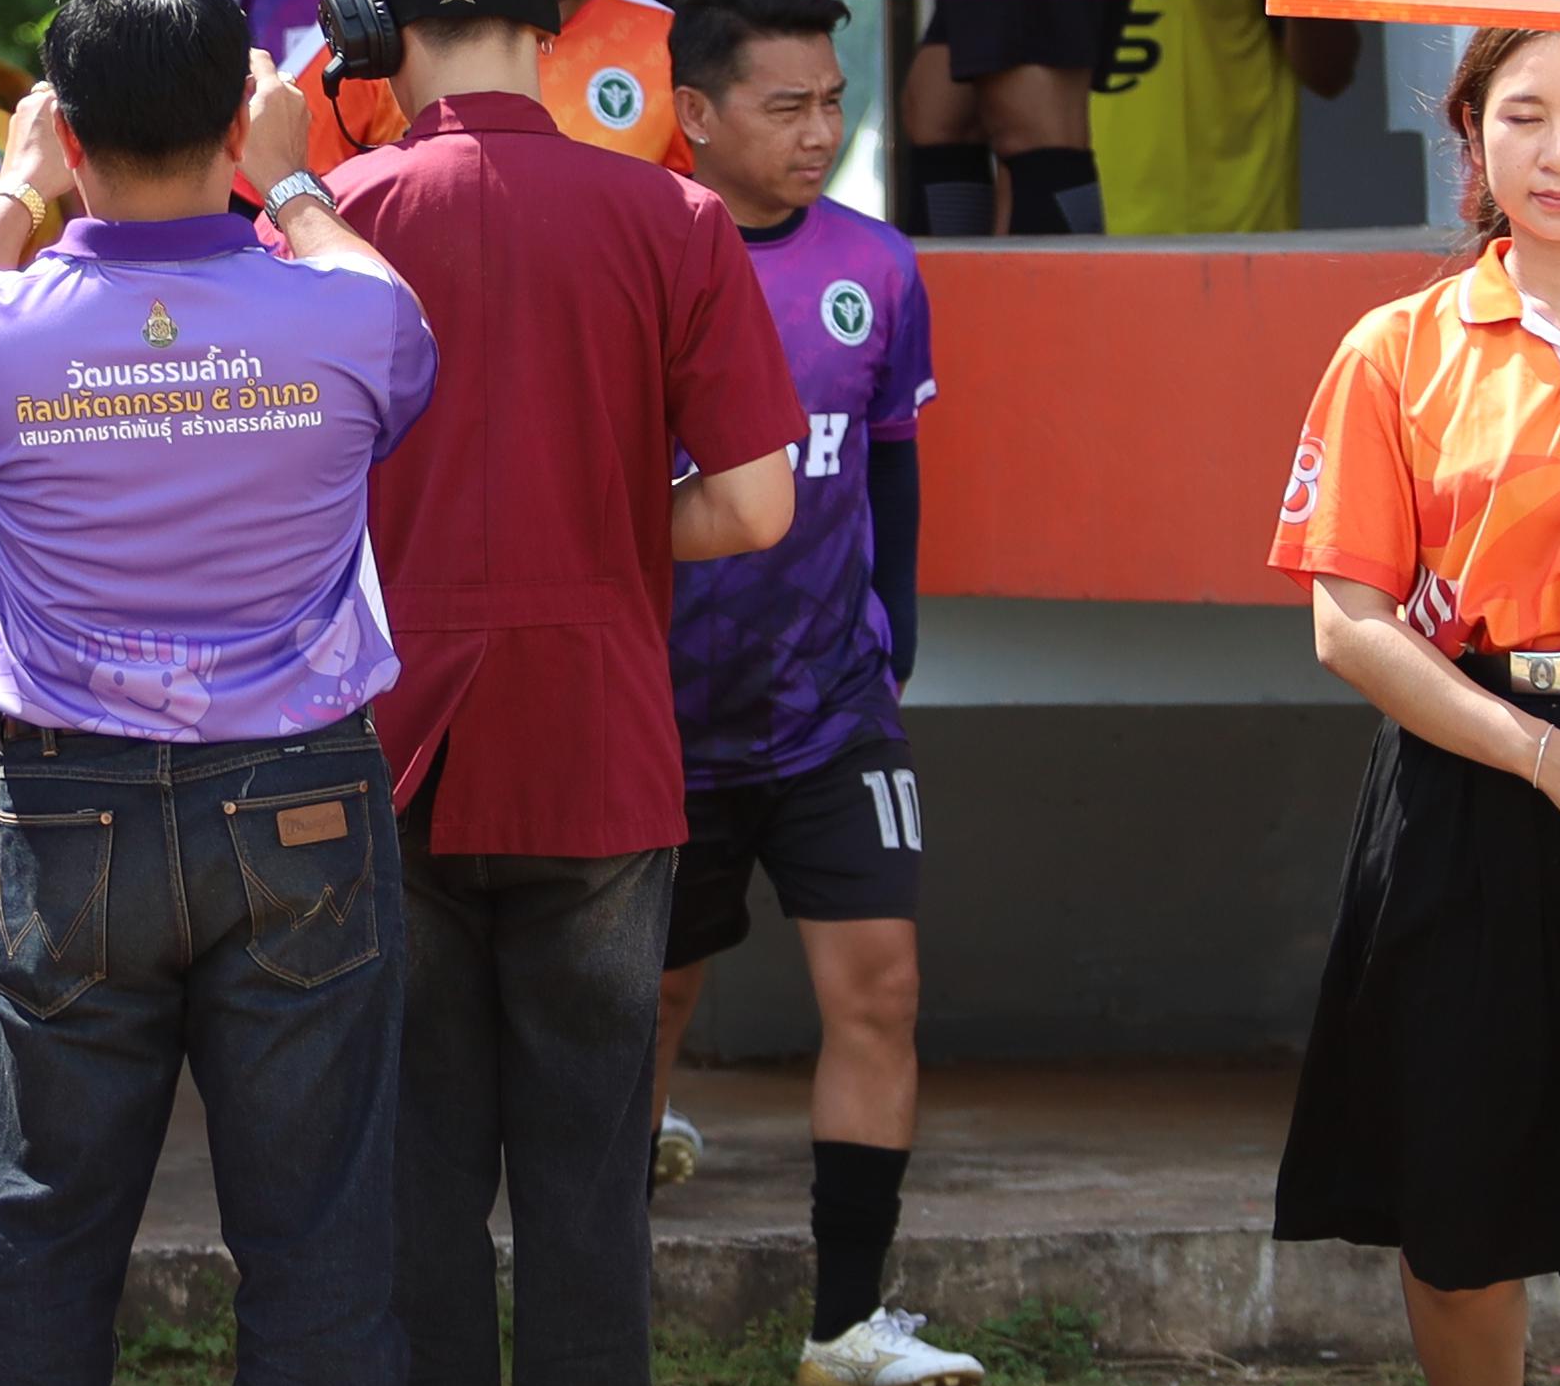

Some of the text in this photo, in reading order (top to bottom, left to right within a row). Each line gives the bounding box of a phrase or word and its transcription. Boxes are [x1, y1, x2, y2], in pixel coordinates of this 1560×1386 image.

[67, 345, 263, 391] วัฒนธรรมล้ำค่า
[16, 386, 204, 424] ศิลปหัตถกรรม
[238, 377, 321, 410] อำเภอ
[19, 408, 323, 448] เสมอภาคชาติพันธุ์ สร้างสรรค์สังคม
[861, 767, 924, 853] 10
